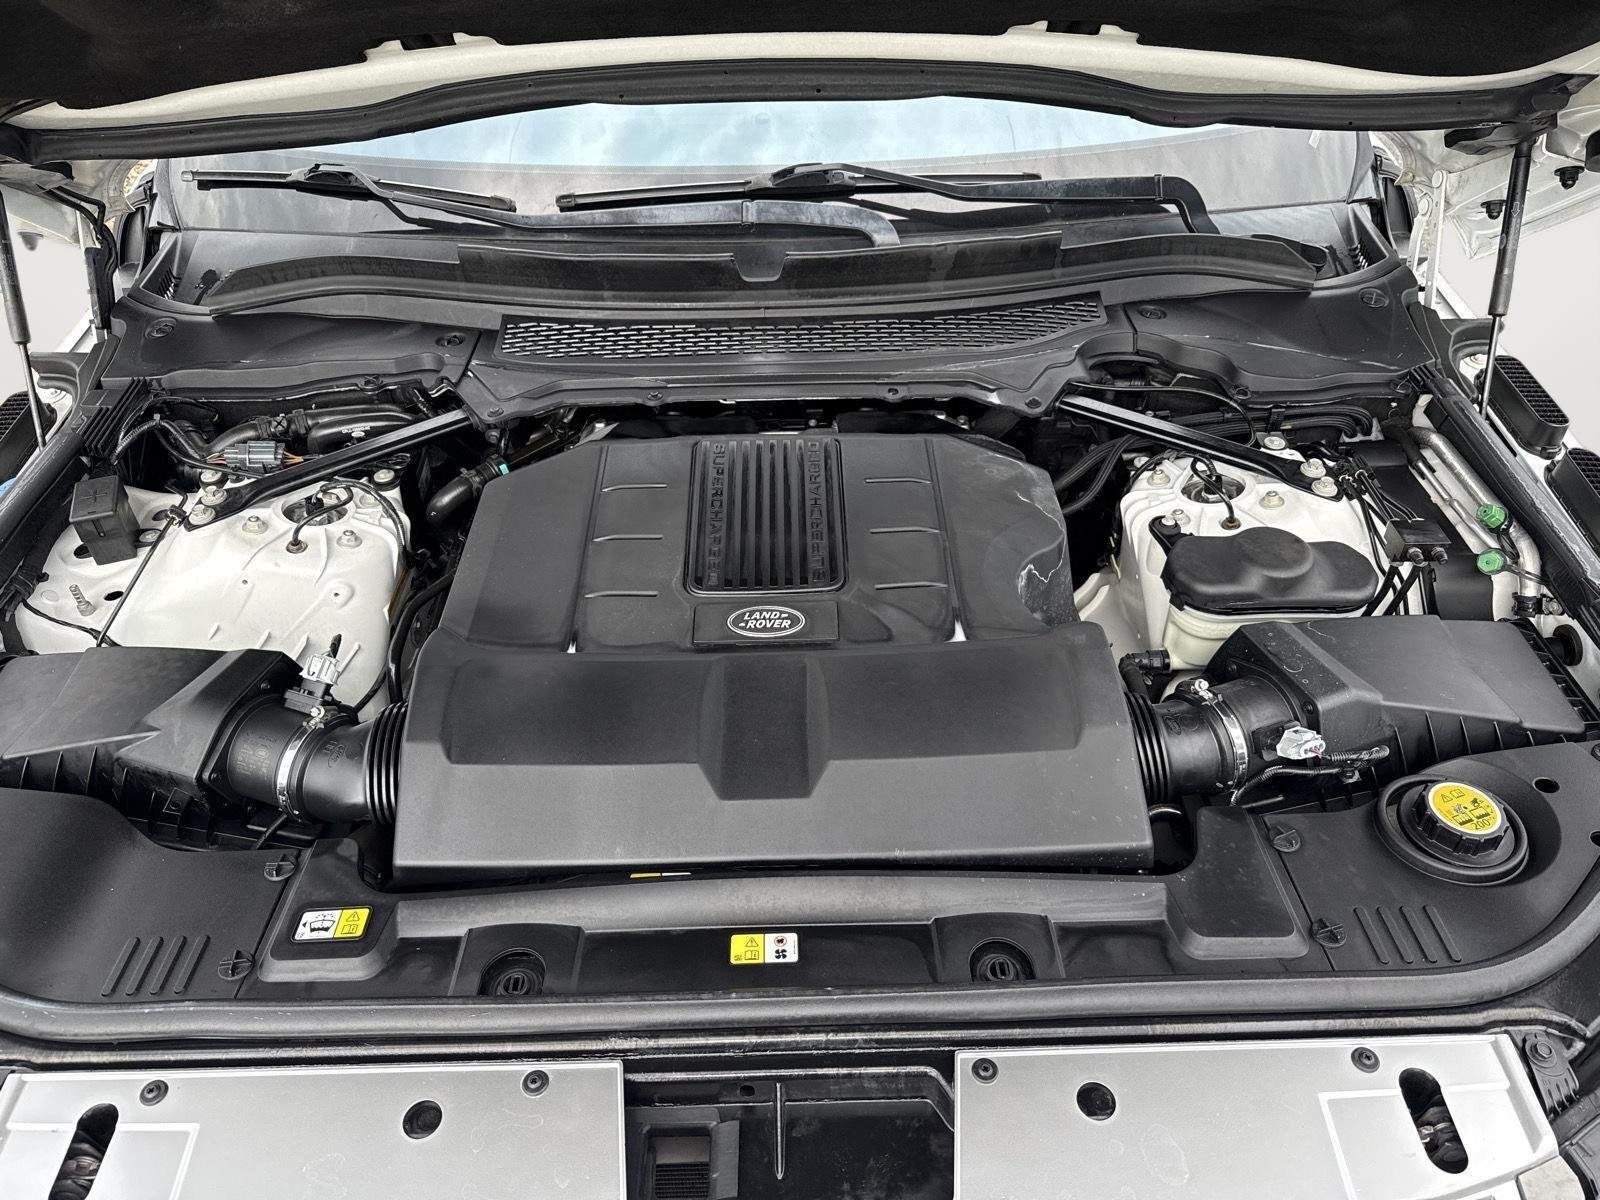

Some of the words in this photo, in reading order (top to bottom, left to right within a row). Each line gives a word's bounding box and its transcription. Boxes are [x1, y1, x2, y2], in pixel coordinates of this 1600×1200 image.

[744, 611, 780, 620] LAND
[746, 620, 791, 629] ROVER
[1471, 819, 1491, 830] 200
